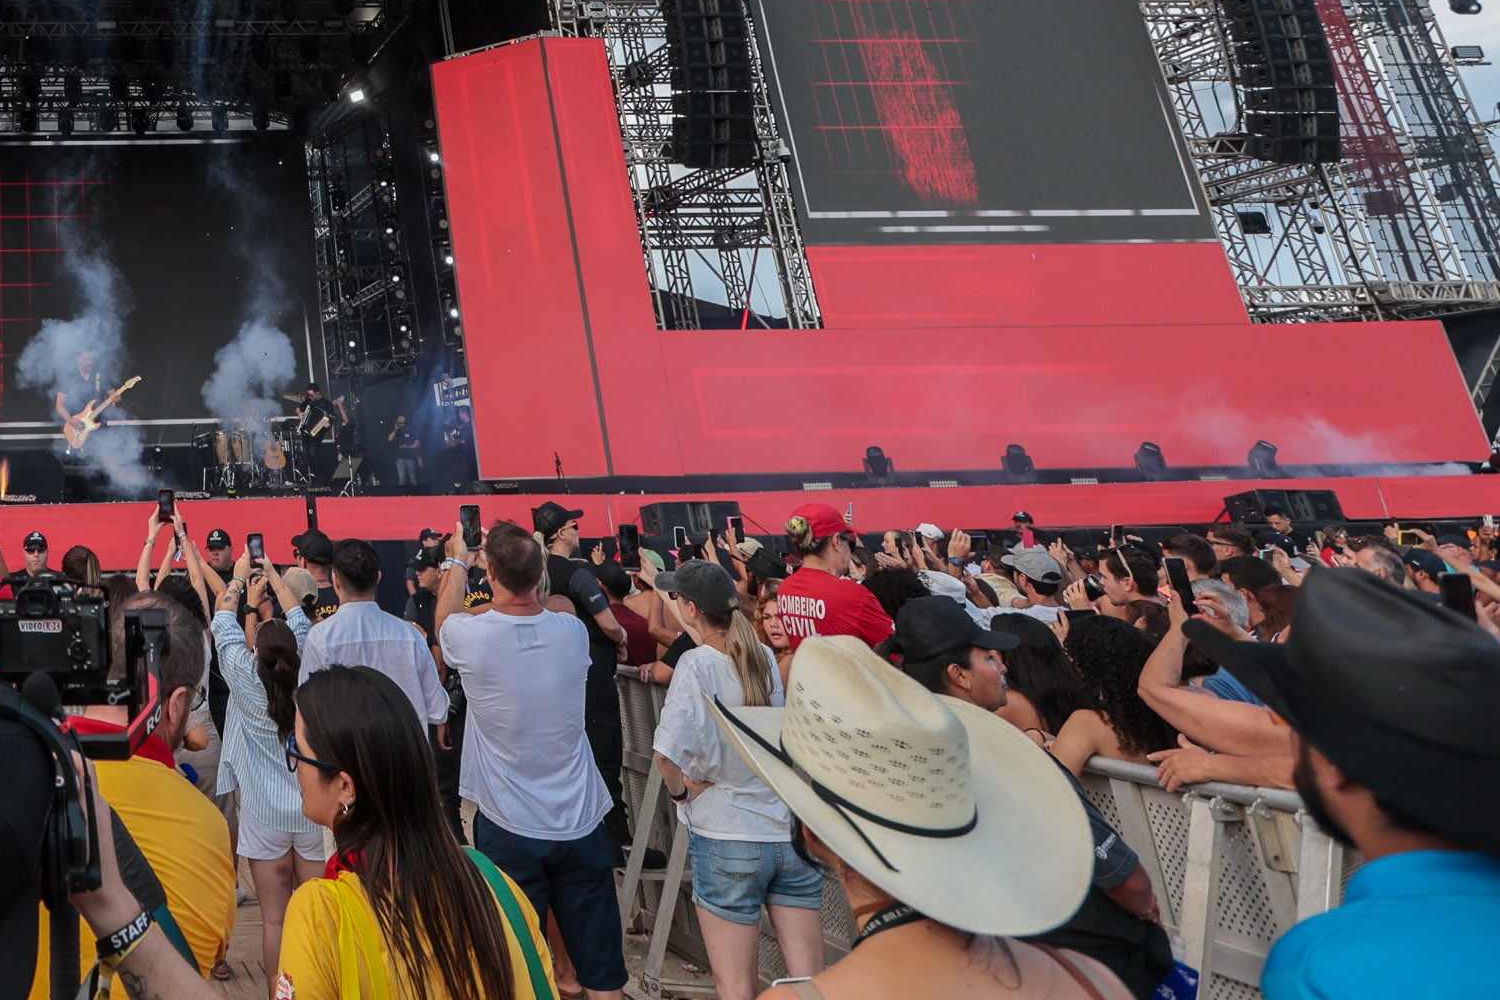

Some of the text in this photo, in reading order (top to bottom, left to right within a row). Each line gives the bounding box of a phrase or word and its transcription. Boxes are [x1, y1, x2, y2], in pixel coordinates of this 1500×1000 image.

[777, 594, 826, 620] BOMBEIRO
[782, 615, 822, 638] CIVIL
[110, 911, 148, 949] STAFF
